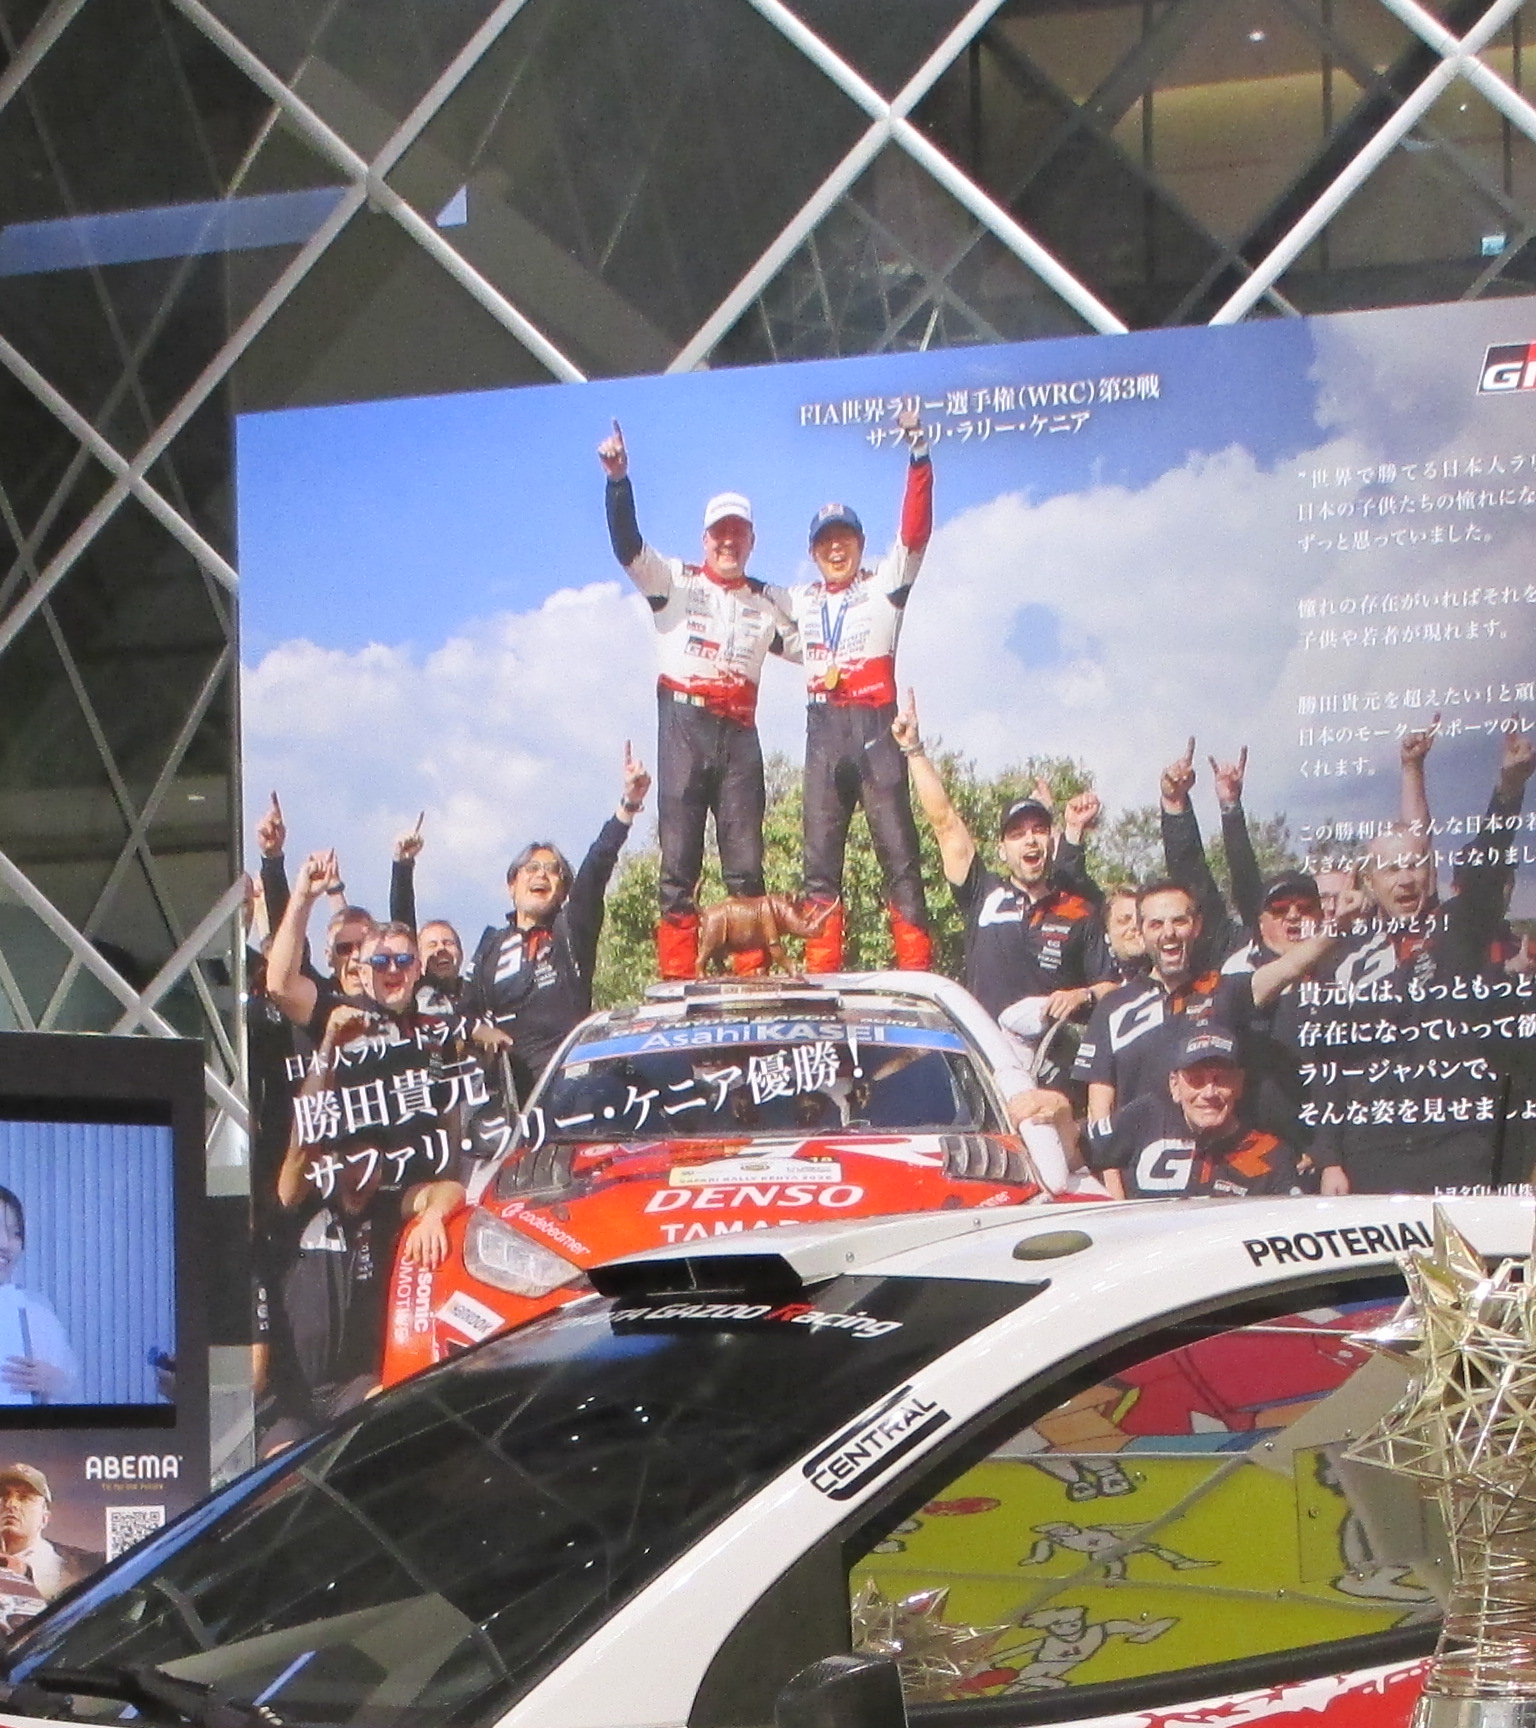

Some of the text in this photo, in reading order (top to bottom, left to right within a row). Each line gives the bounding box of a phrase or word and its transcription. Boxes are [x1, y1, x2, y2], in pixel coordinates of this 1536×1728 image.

[1298, 526, 1493, 554] ずっと思っていました。
[1298, 619, 1509, 650] 子供や若者が現れます。
[1299, 756, 1378, 778] くれます。
[293, 1053, 492, 1148] 勝田貴元
[644, 1184, 867, 1213] DENSO
[661, 1216, 811, 1245] TAMA
[810, 1394, 939, 1495] CENTRAL
[84, 1454, 180, 1480] ABEMA
